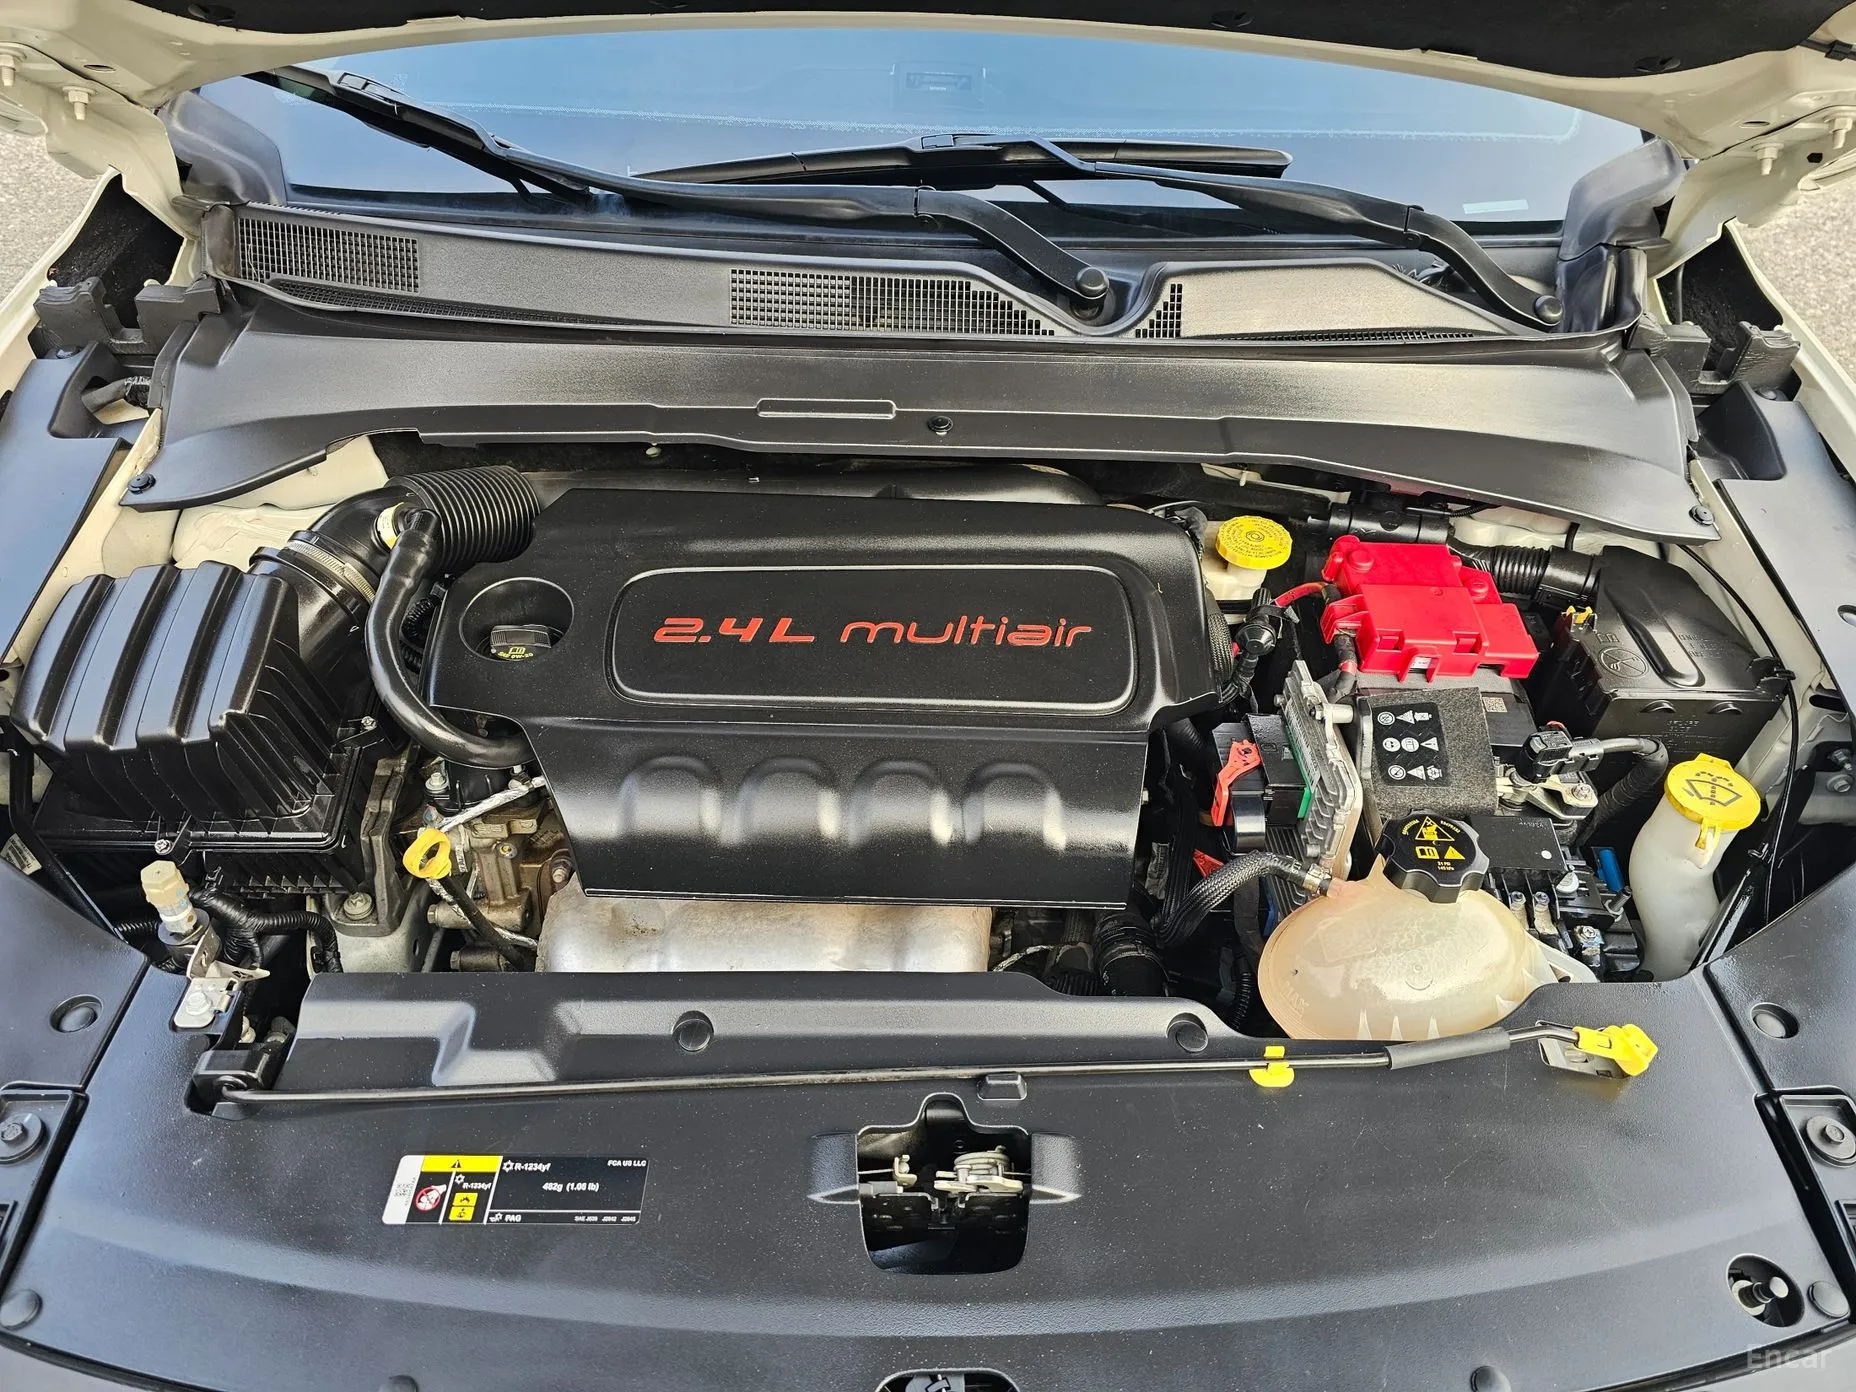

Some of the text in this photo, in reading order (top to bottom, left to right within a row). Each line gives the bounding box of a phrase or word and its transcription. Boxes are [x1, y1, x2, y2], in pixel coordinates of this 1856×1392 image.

[653, 614, 1092, 647] 2.4L multiair
[514, 1161, 551, 1172] R-1234yf
[607, 1159, 622, 1167] FCA
[632, 1159, 647, 1167] LLC
[587, 1182, 600, 1192] lb)
[504, 1214, 522, 1222] PAG
